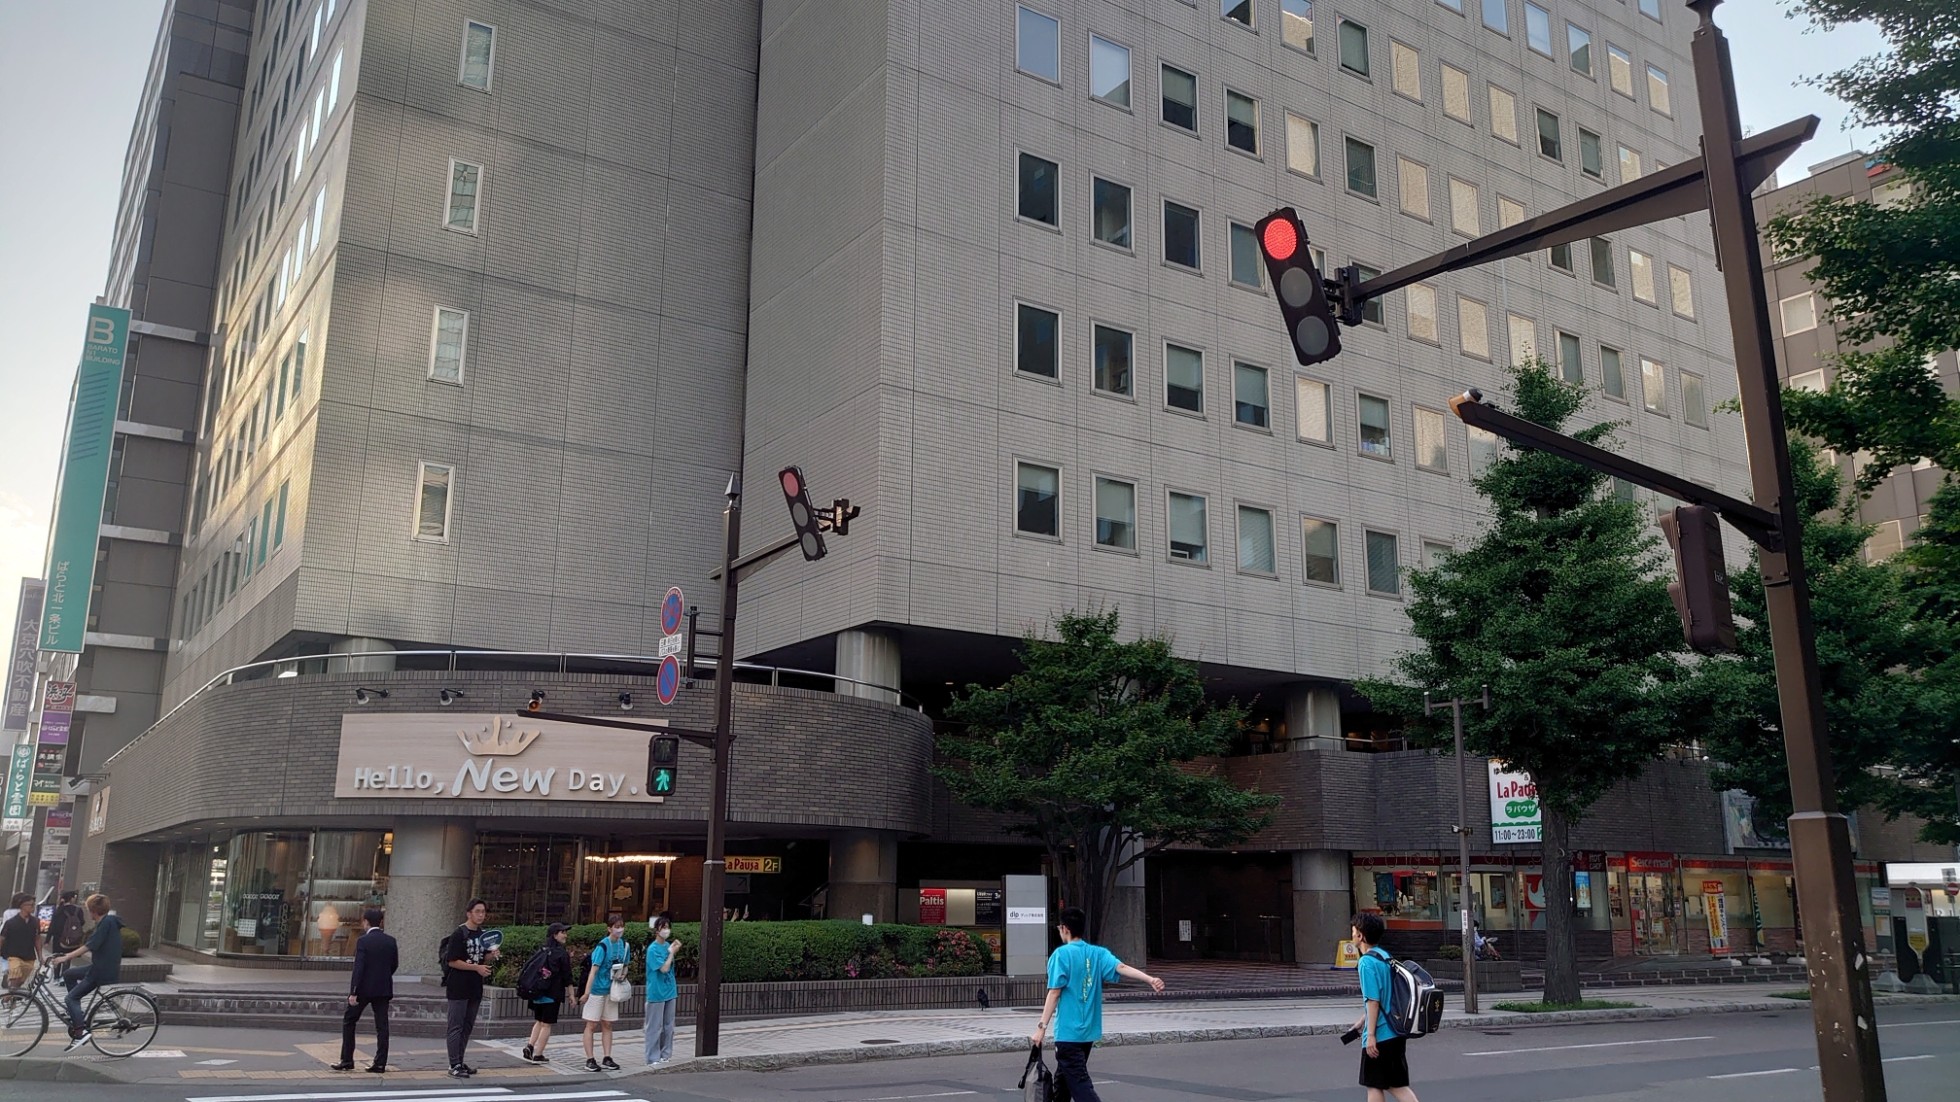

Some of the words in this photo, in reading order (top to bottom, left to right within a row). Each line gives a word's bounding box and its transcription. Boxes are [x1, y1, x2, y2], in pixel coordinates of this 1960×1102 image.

[88, 316, 115, 345] B
[46, 560, 70, 645] ばらと北一条ビル
[8, 619, 39, 717] 大京穴吹不動産
[353, 765, 447, 794] Hello,
[451, 757, 556, 797] New
[568, 767, 639, 798] Day.
[764, 859, 779, 872] 2F
[919, 896, 945, 906] Paltis
